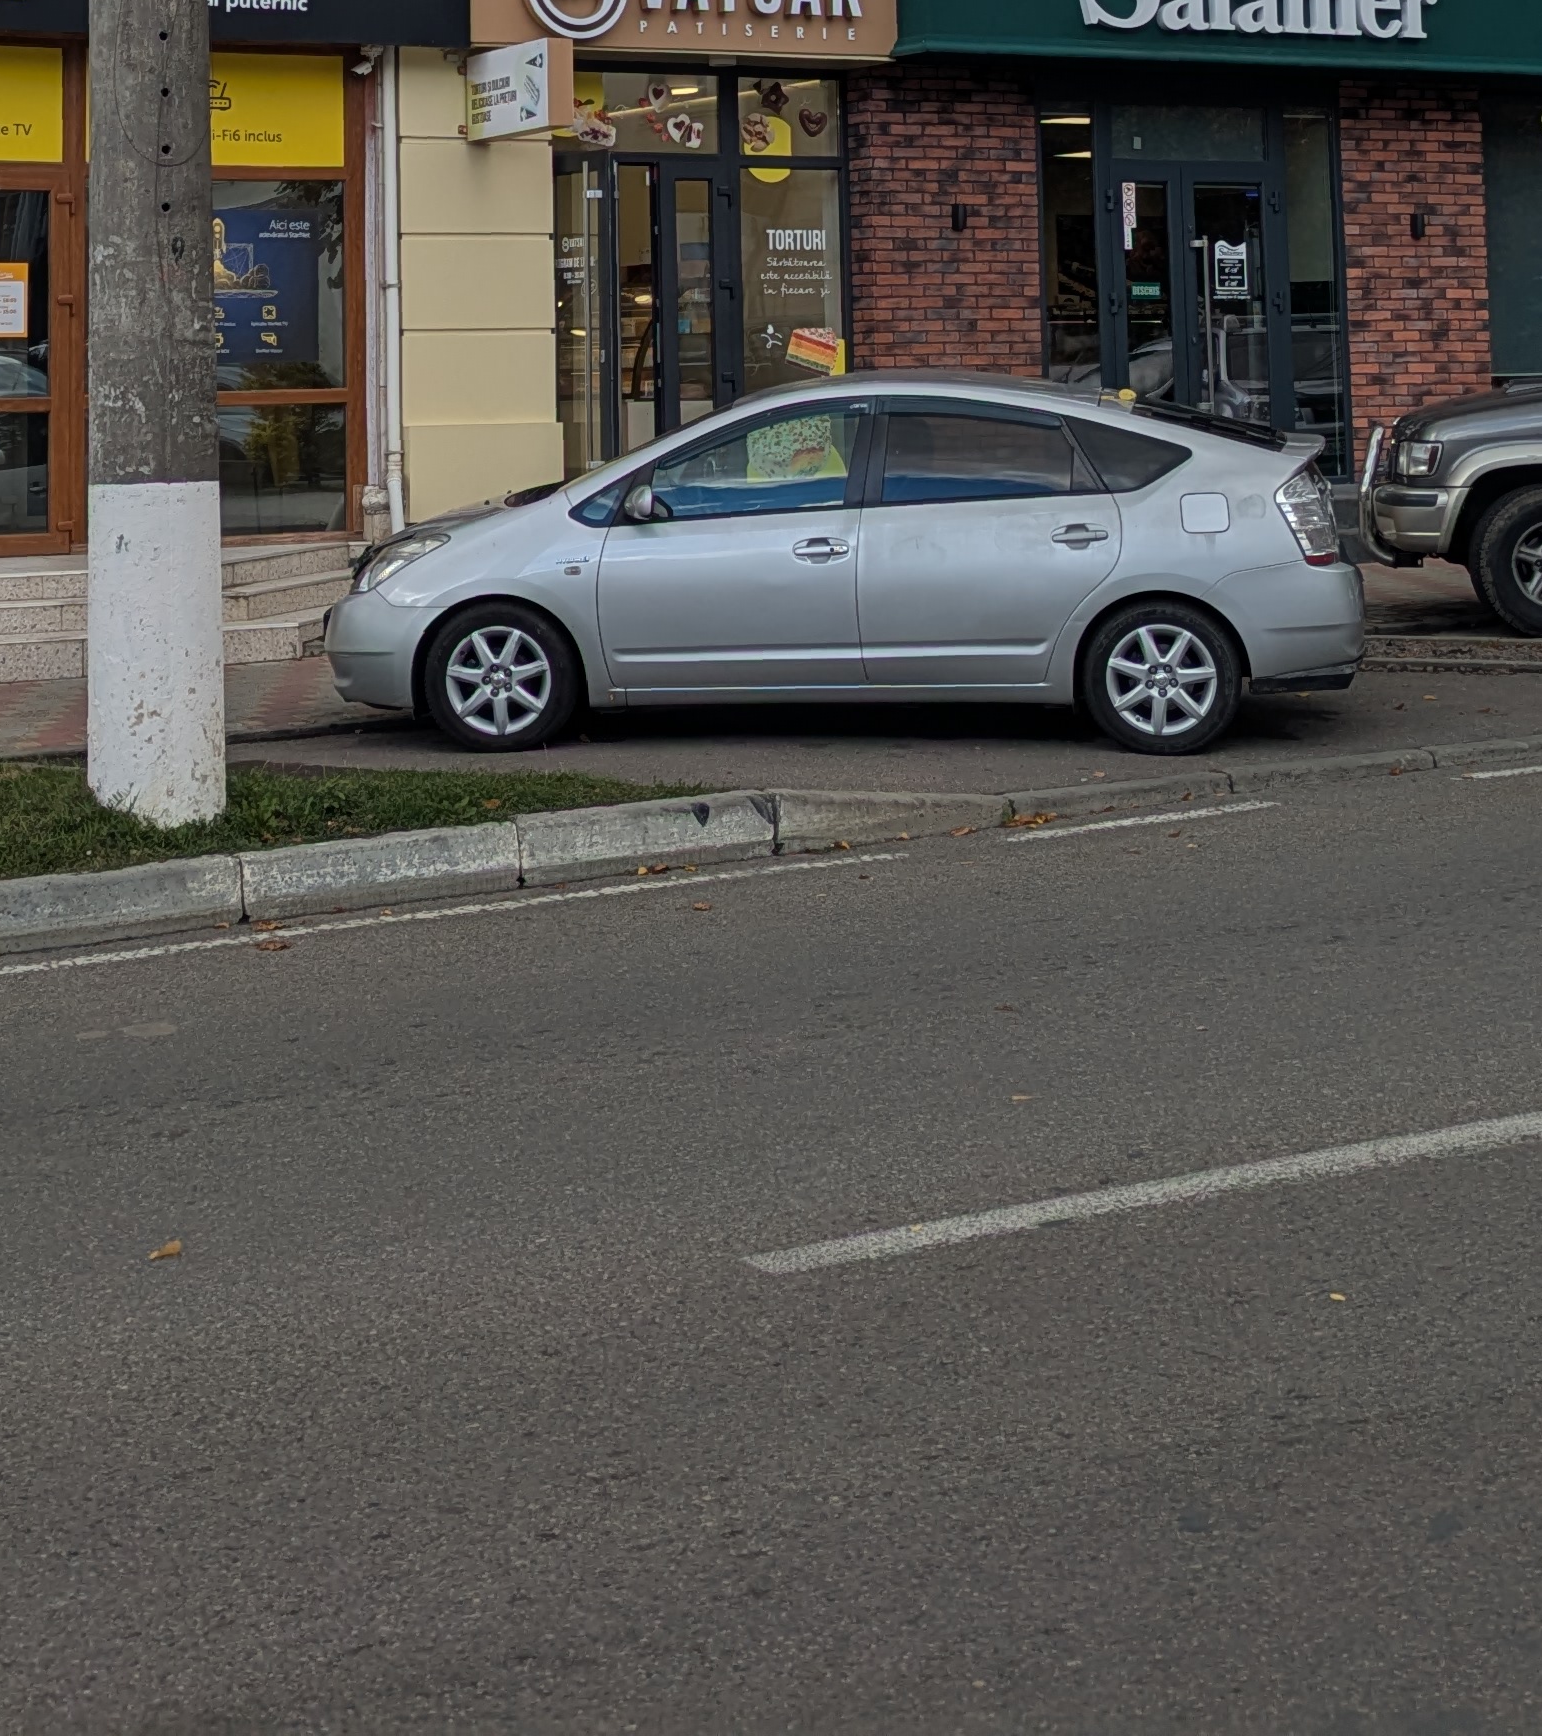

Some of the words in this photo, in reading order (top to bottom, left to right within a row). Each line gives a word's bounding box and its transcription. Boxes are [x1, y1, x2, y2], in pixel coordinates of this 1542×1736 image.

[639, 20, 856, 41] PATISERIE
[13, 123, 33, 136] TV
[211, 129, 241, 142] i-Fi6
[244, 130, 283, 143] inclus
[269, 219, 288, 230] Aici
[289, 221, 310, 231] este
[766, 229, 826, 250] TORTURI
[760, 270, 780, 280] este
[781, 282, 815, 298] fiecare
